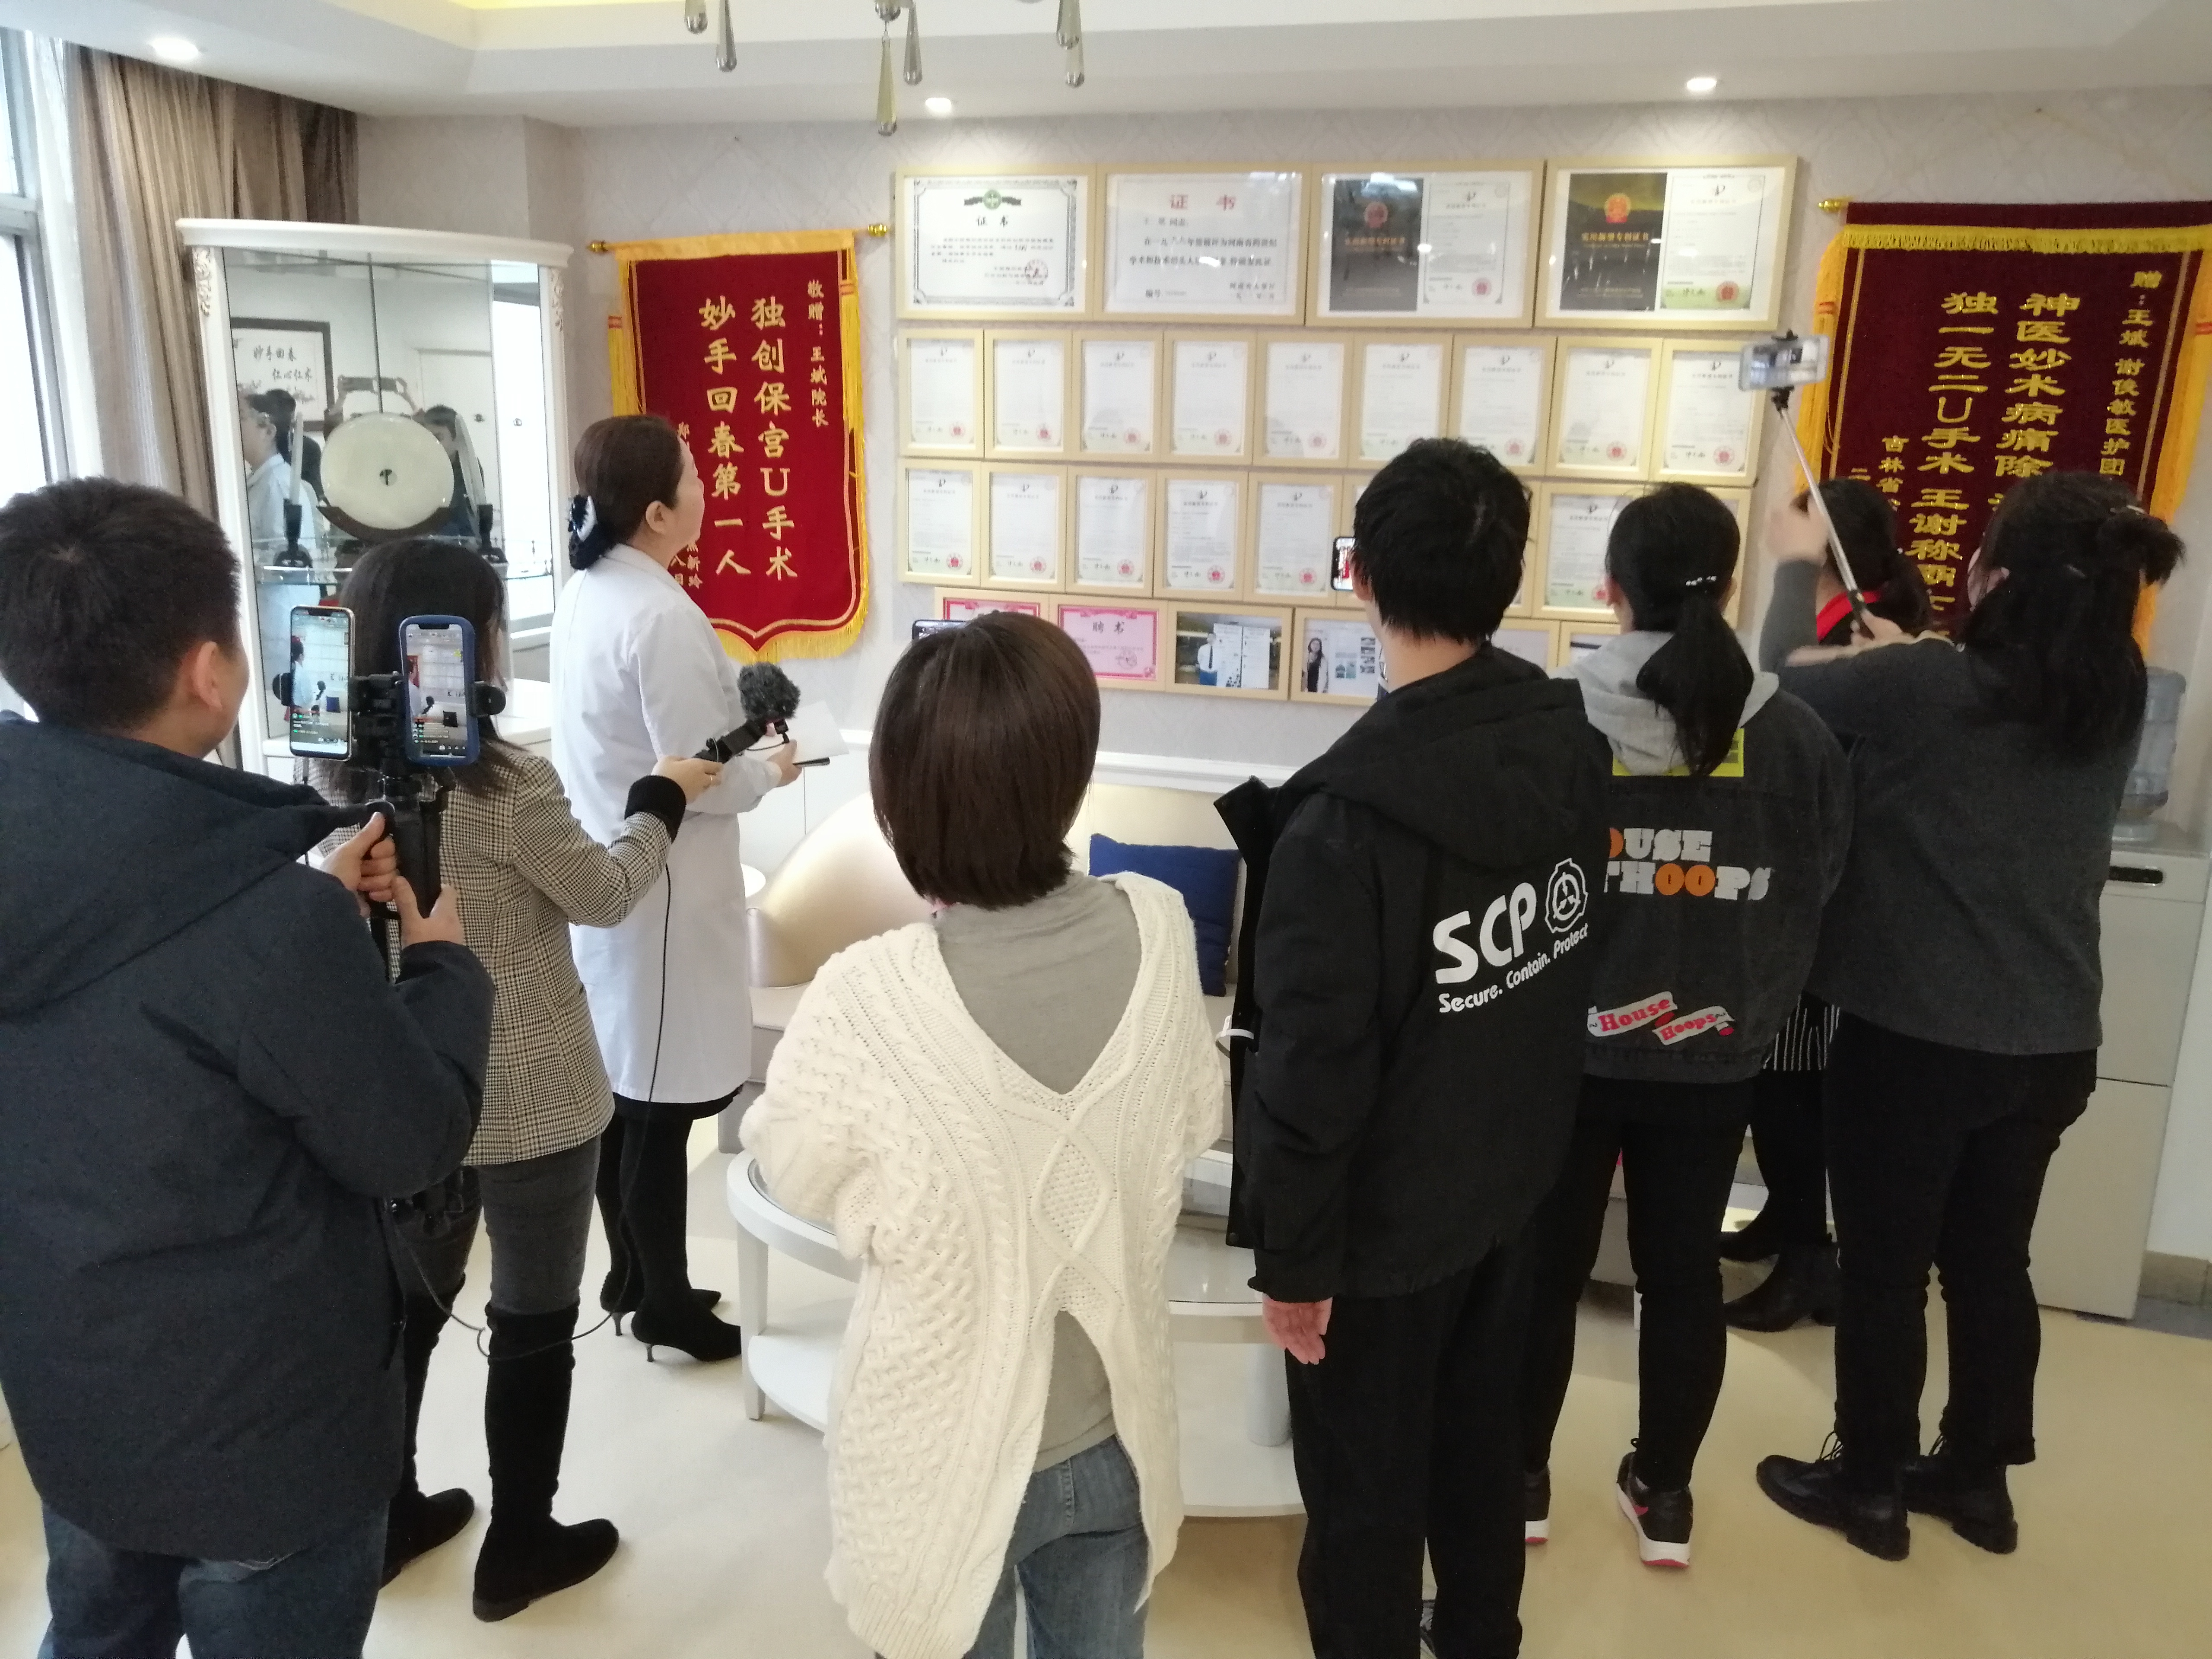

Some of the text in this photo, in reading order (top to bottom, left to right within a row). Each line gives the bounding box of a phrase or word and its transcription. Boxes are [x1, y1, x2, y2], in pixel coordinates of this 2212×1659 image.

[1170, 194, 1236, 211] 证书
[699, 296, 751, 575] 妙手回春第一人
[751, 296, 798, 581] 独创保宫U手术
[1876, 435, 1909, 512] 吉林省
[1433, 882, 1537, 984] SCP
[1439, 922, 1589, 1013] Secure. Contain. Protect
[1598, 999, 1671, 1032] House
[1659, 1014, 1717, 1041] Hoops
